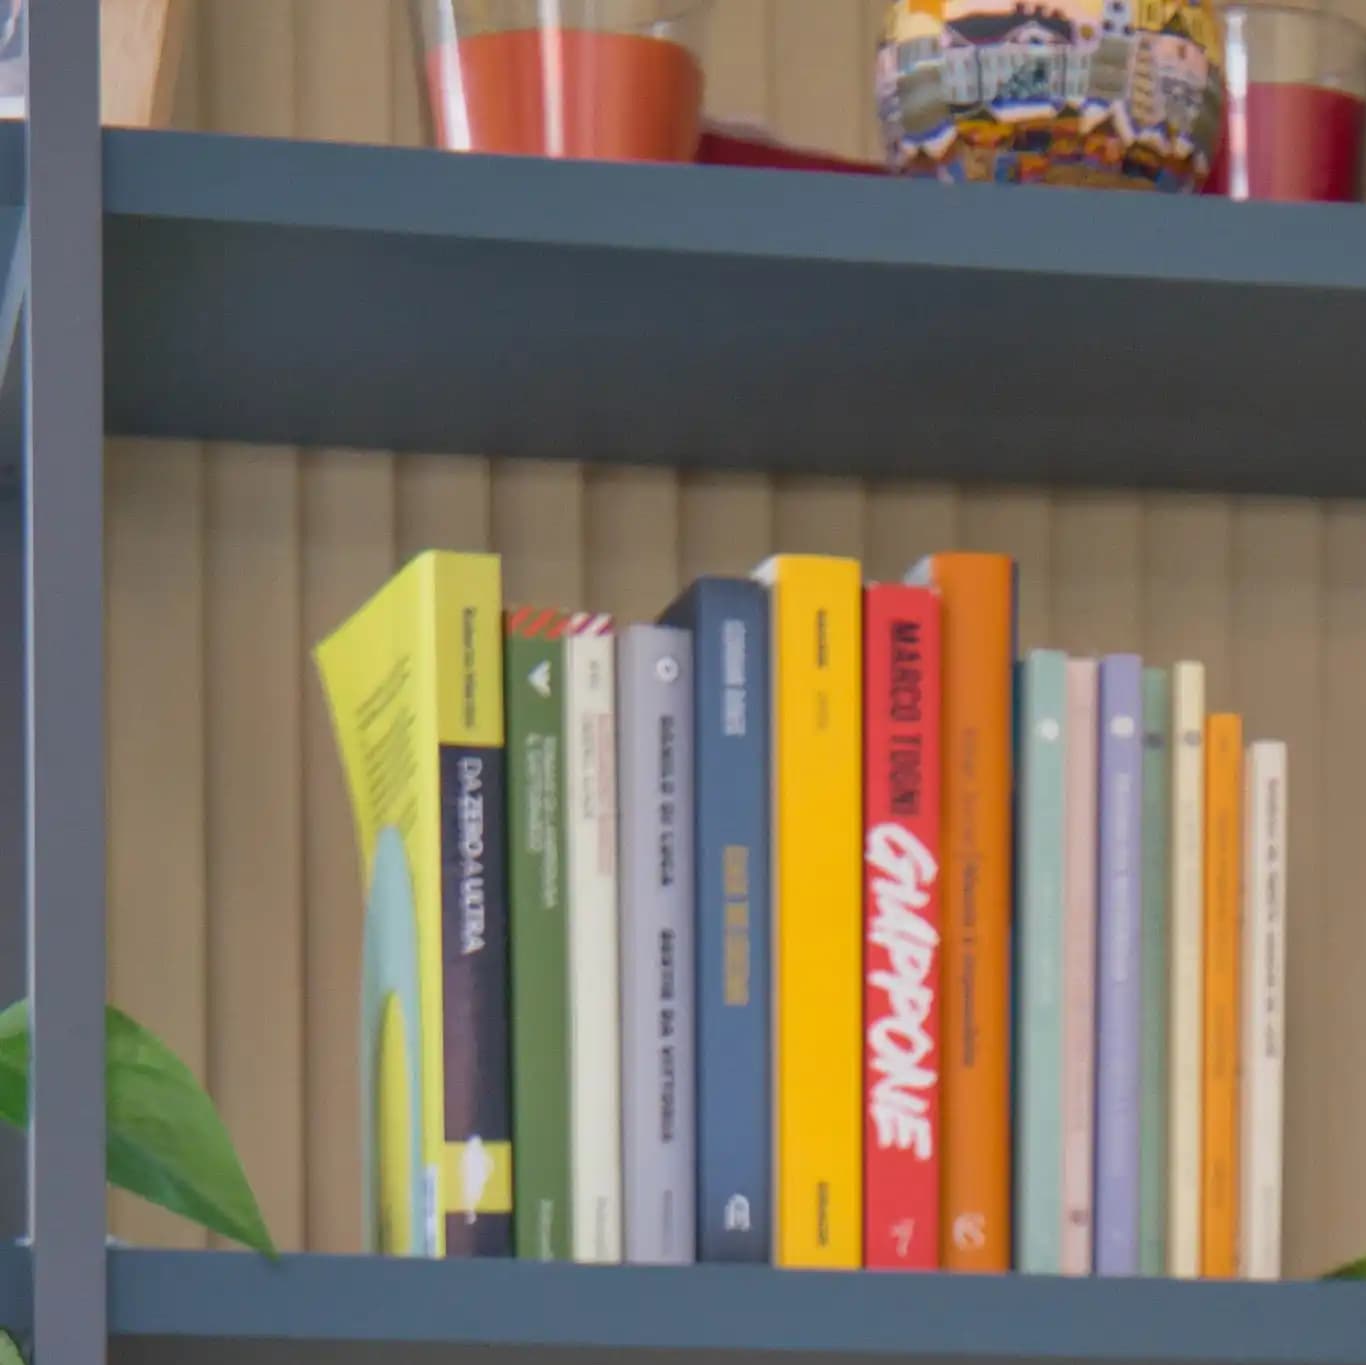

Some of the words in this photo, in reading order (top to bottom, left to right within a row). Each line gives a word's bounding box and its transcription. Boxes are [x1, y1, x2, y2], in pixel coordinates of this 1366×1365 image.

[891, 619, 921, 721] MARCO
[457, 756, 483, 792] DA
[458, 793, 484, 860] ZERO
[460, 877, 487, 955] ULTRA
[864, 823, 940, 1161] GIAPPONE
